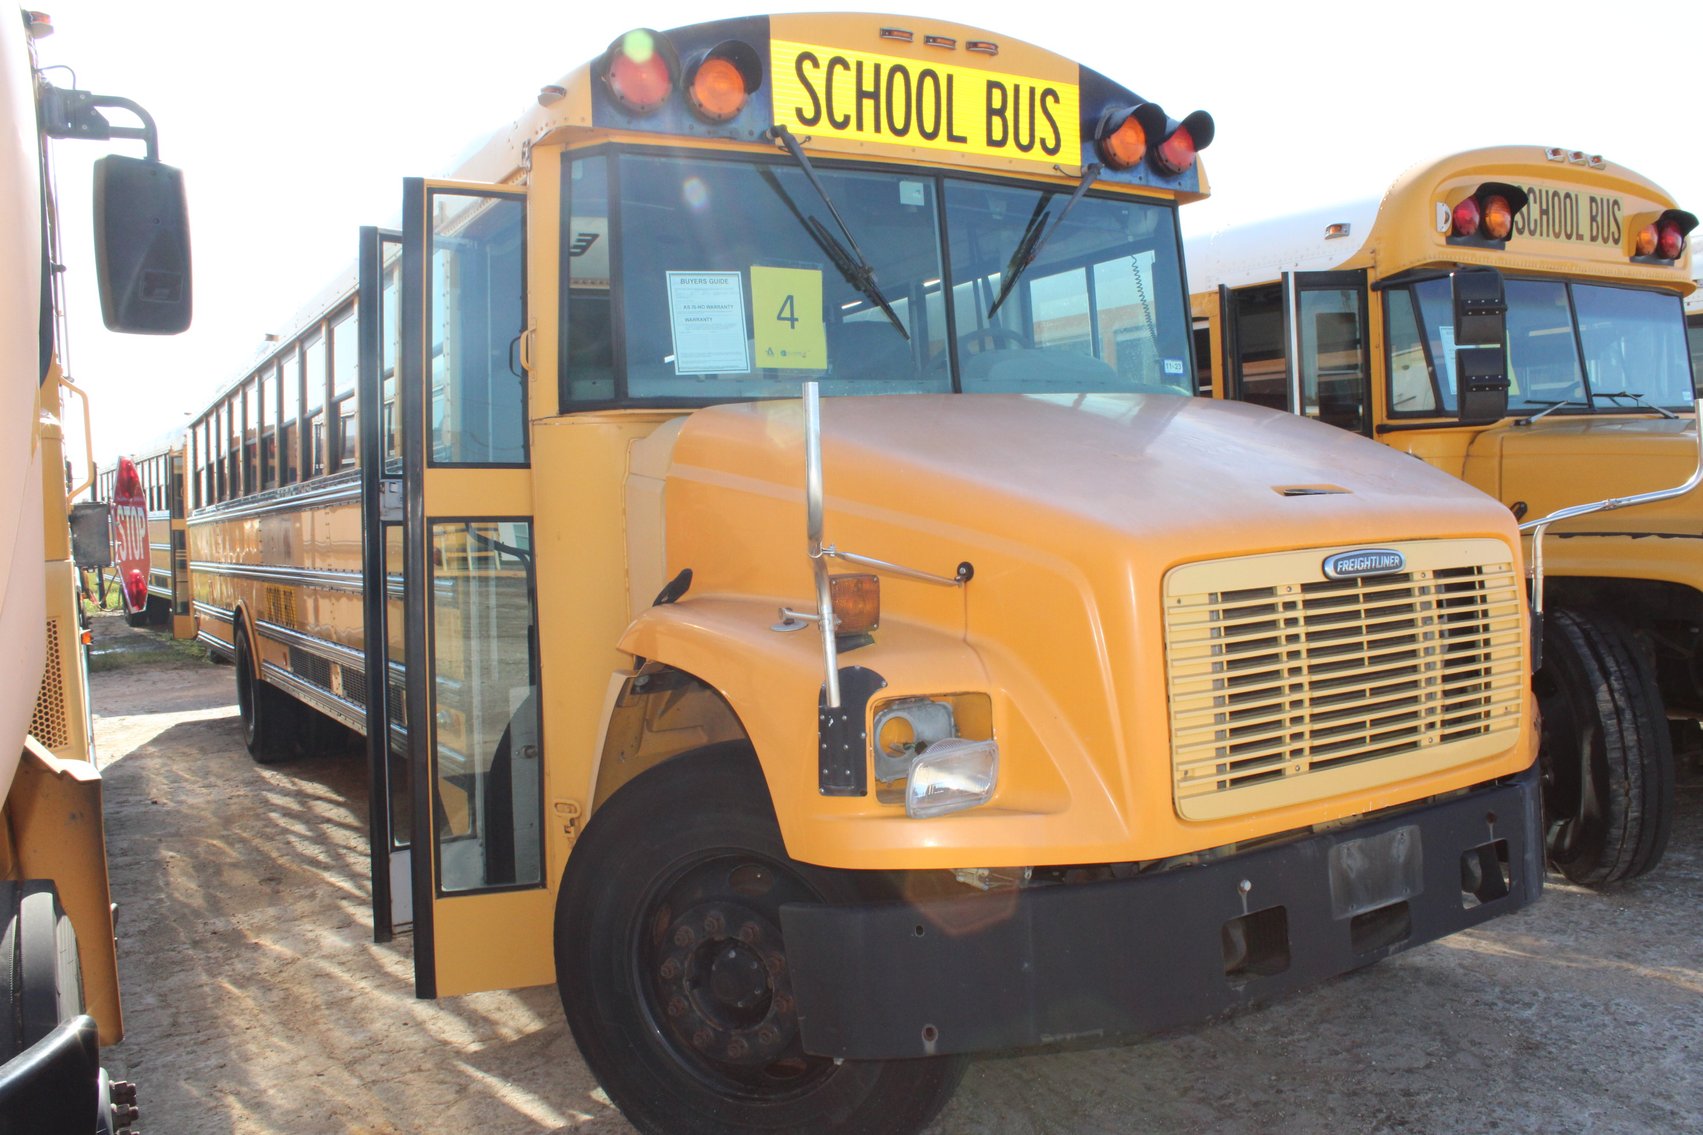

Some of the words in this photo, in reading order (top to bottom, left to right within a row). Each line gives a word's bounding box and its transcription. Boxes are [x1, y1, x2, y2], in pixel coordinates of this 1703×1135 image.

[795, 51, 967, 144] SCHOOL
[986, 79, 1062, 156] BUS
[1589, 196, 1621, 245] BUS
[776, 294, 799, 330] 4
[116, 504, 146, 562] STOP
[1337, 555, 1400, 572] FREIGHTLINER
